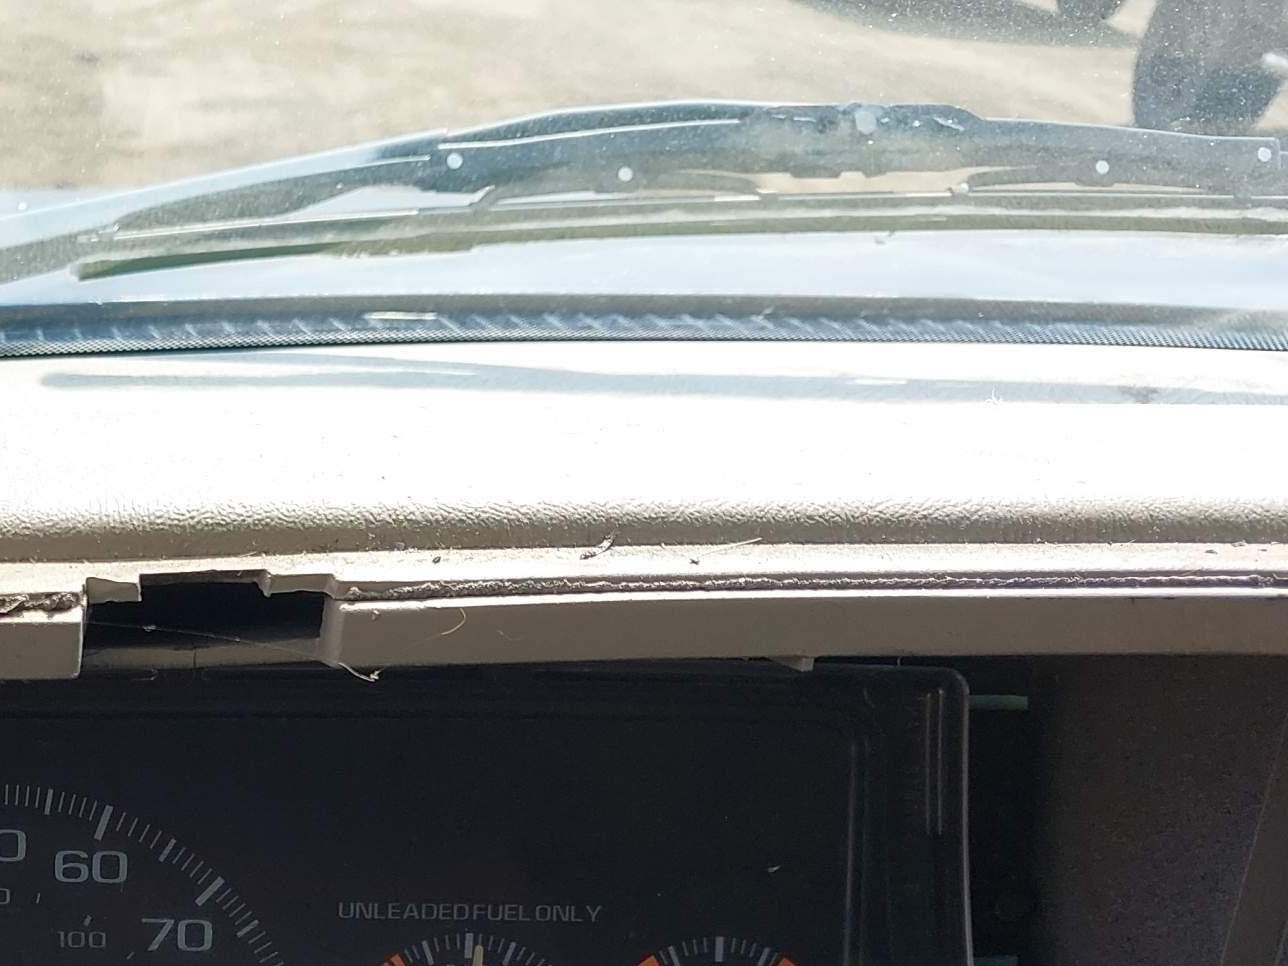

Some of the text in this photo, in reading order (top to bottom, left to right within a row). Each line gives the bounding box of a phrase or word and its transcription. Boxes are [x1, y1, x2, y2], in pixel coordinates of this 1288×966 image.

[55, 851, 127, 883] 60
[58, 931, 106, 948] 100
[142, 919, 212, 951] 70
